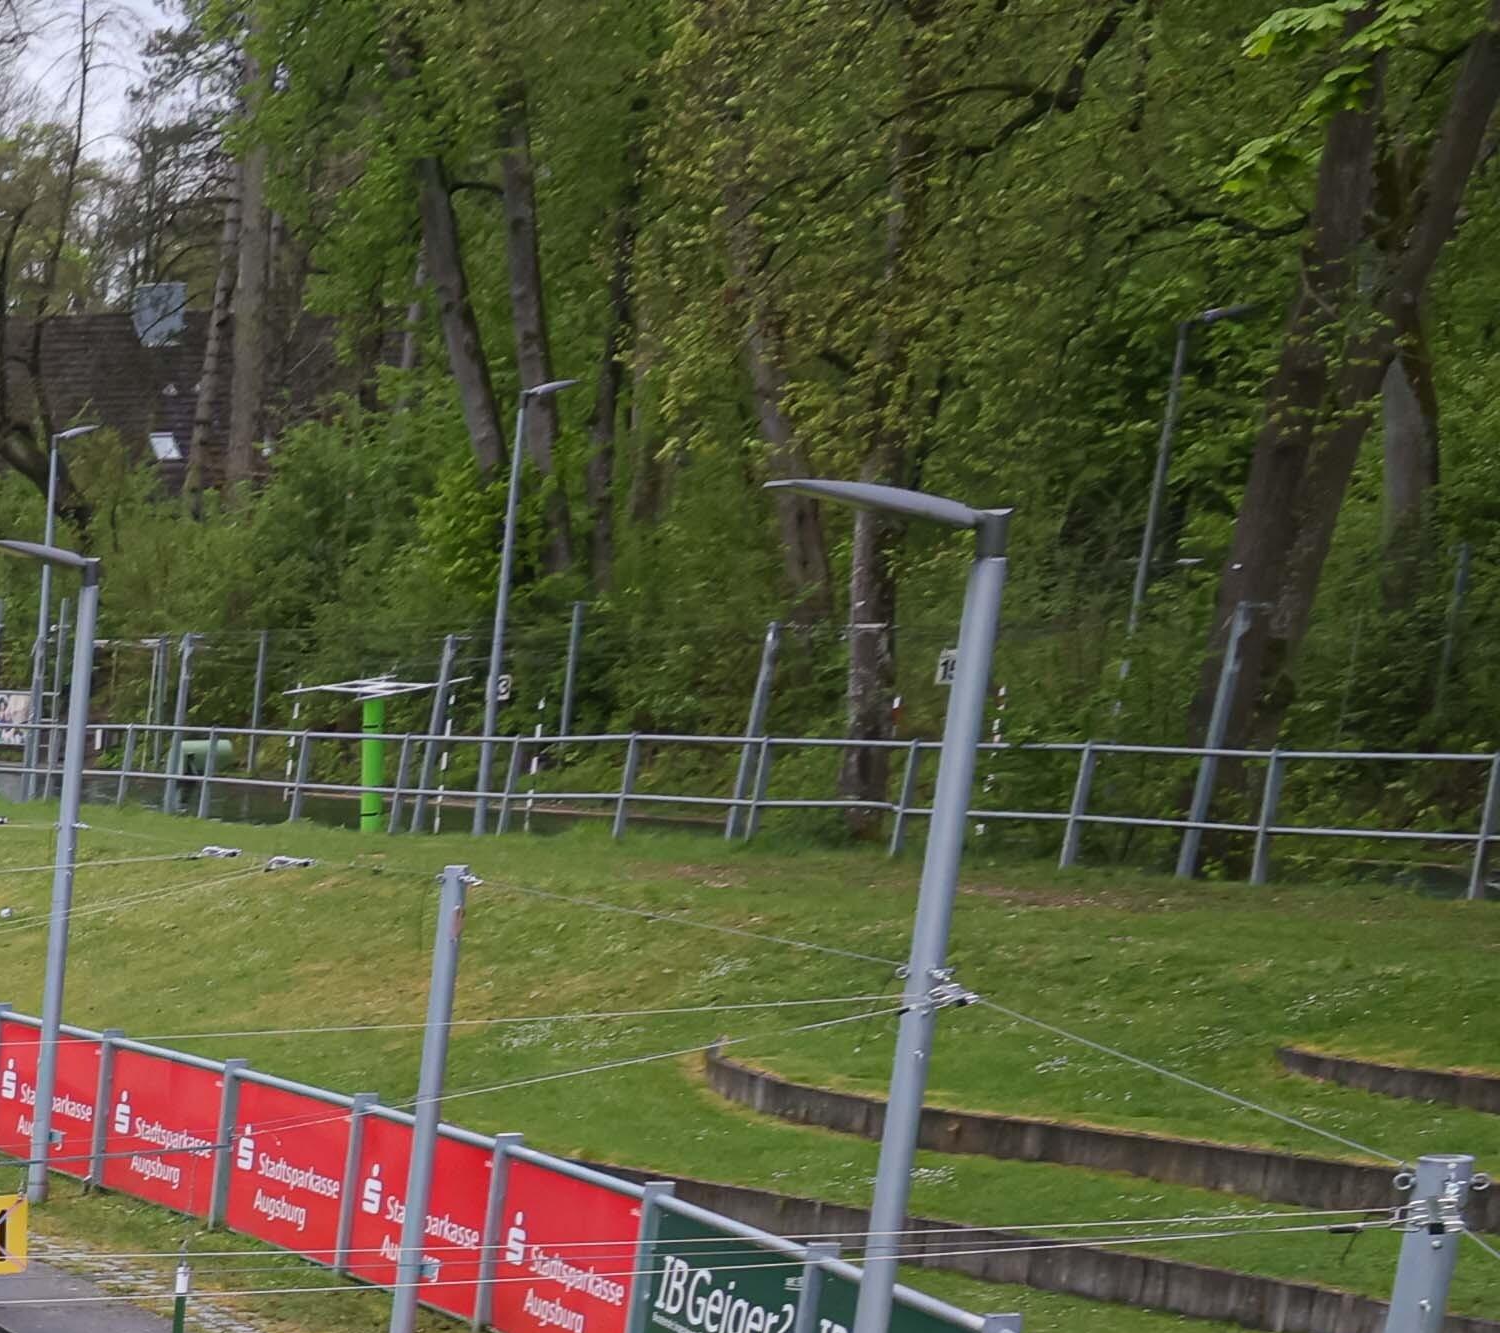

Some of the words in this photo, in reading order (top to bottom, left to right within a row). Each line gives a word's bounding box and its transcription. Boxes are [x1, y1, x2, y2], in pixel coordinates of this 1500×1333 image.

[20, 1083, 93, 1122] Staarkasse
[134, 1116, 213, 1159] Stadtsparkasse
[130, 1154, 181, 1189] Augsburg
[257, 1152, 340, 1199] Stadtsparkasse
[253, 1188, 306, 1232] Augsburg
[385, 1195, 480, 1250] Staarkasse
[528, 1245, 626, 1307] Stadtsparkasse
